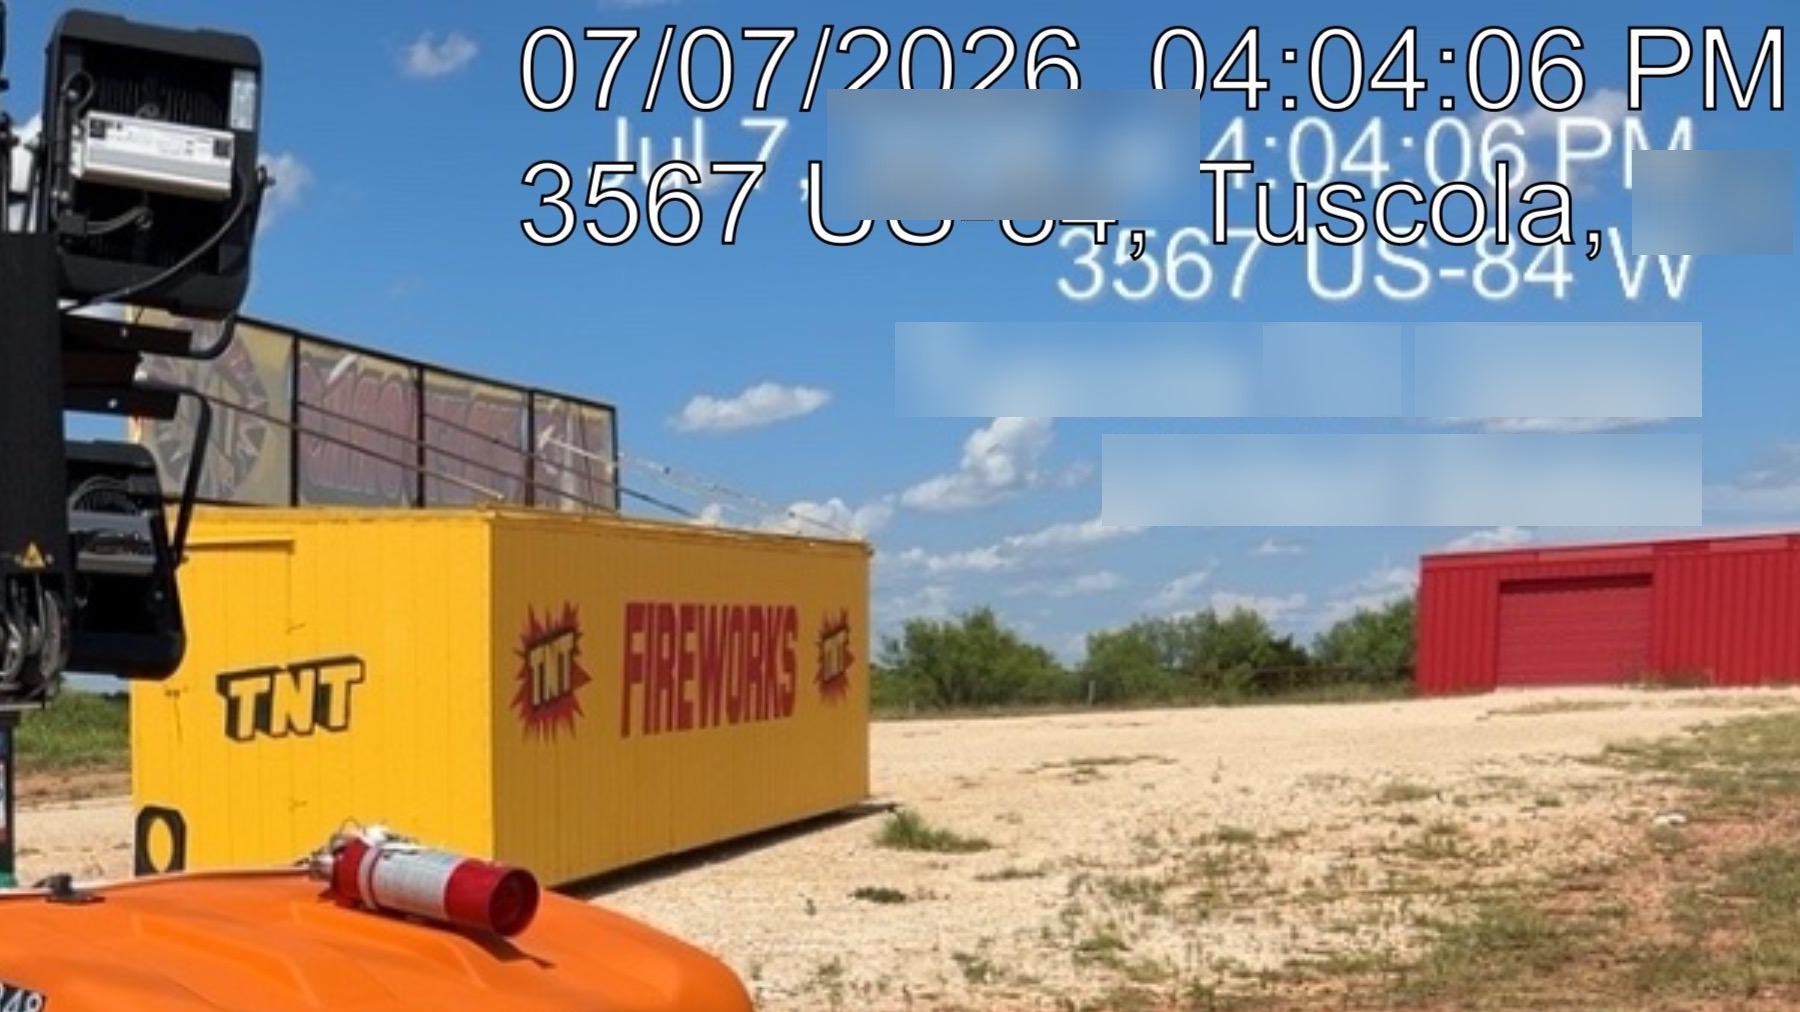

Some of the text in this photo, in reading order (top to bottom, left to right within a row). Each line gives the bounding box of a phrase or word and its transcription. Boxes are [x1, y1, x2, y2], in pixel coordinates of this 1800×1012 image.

[215, 655, 365, 742] TNT
[528, 630, 575, 708] TNT
[620, 602, 797, 739] FIREWORKS
